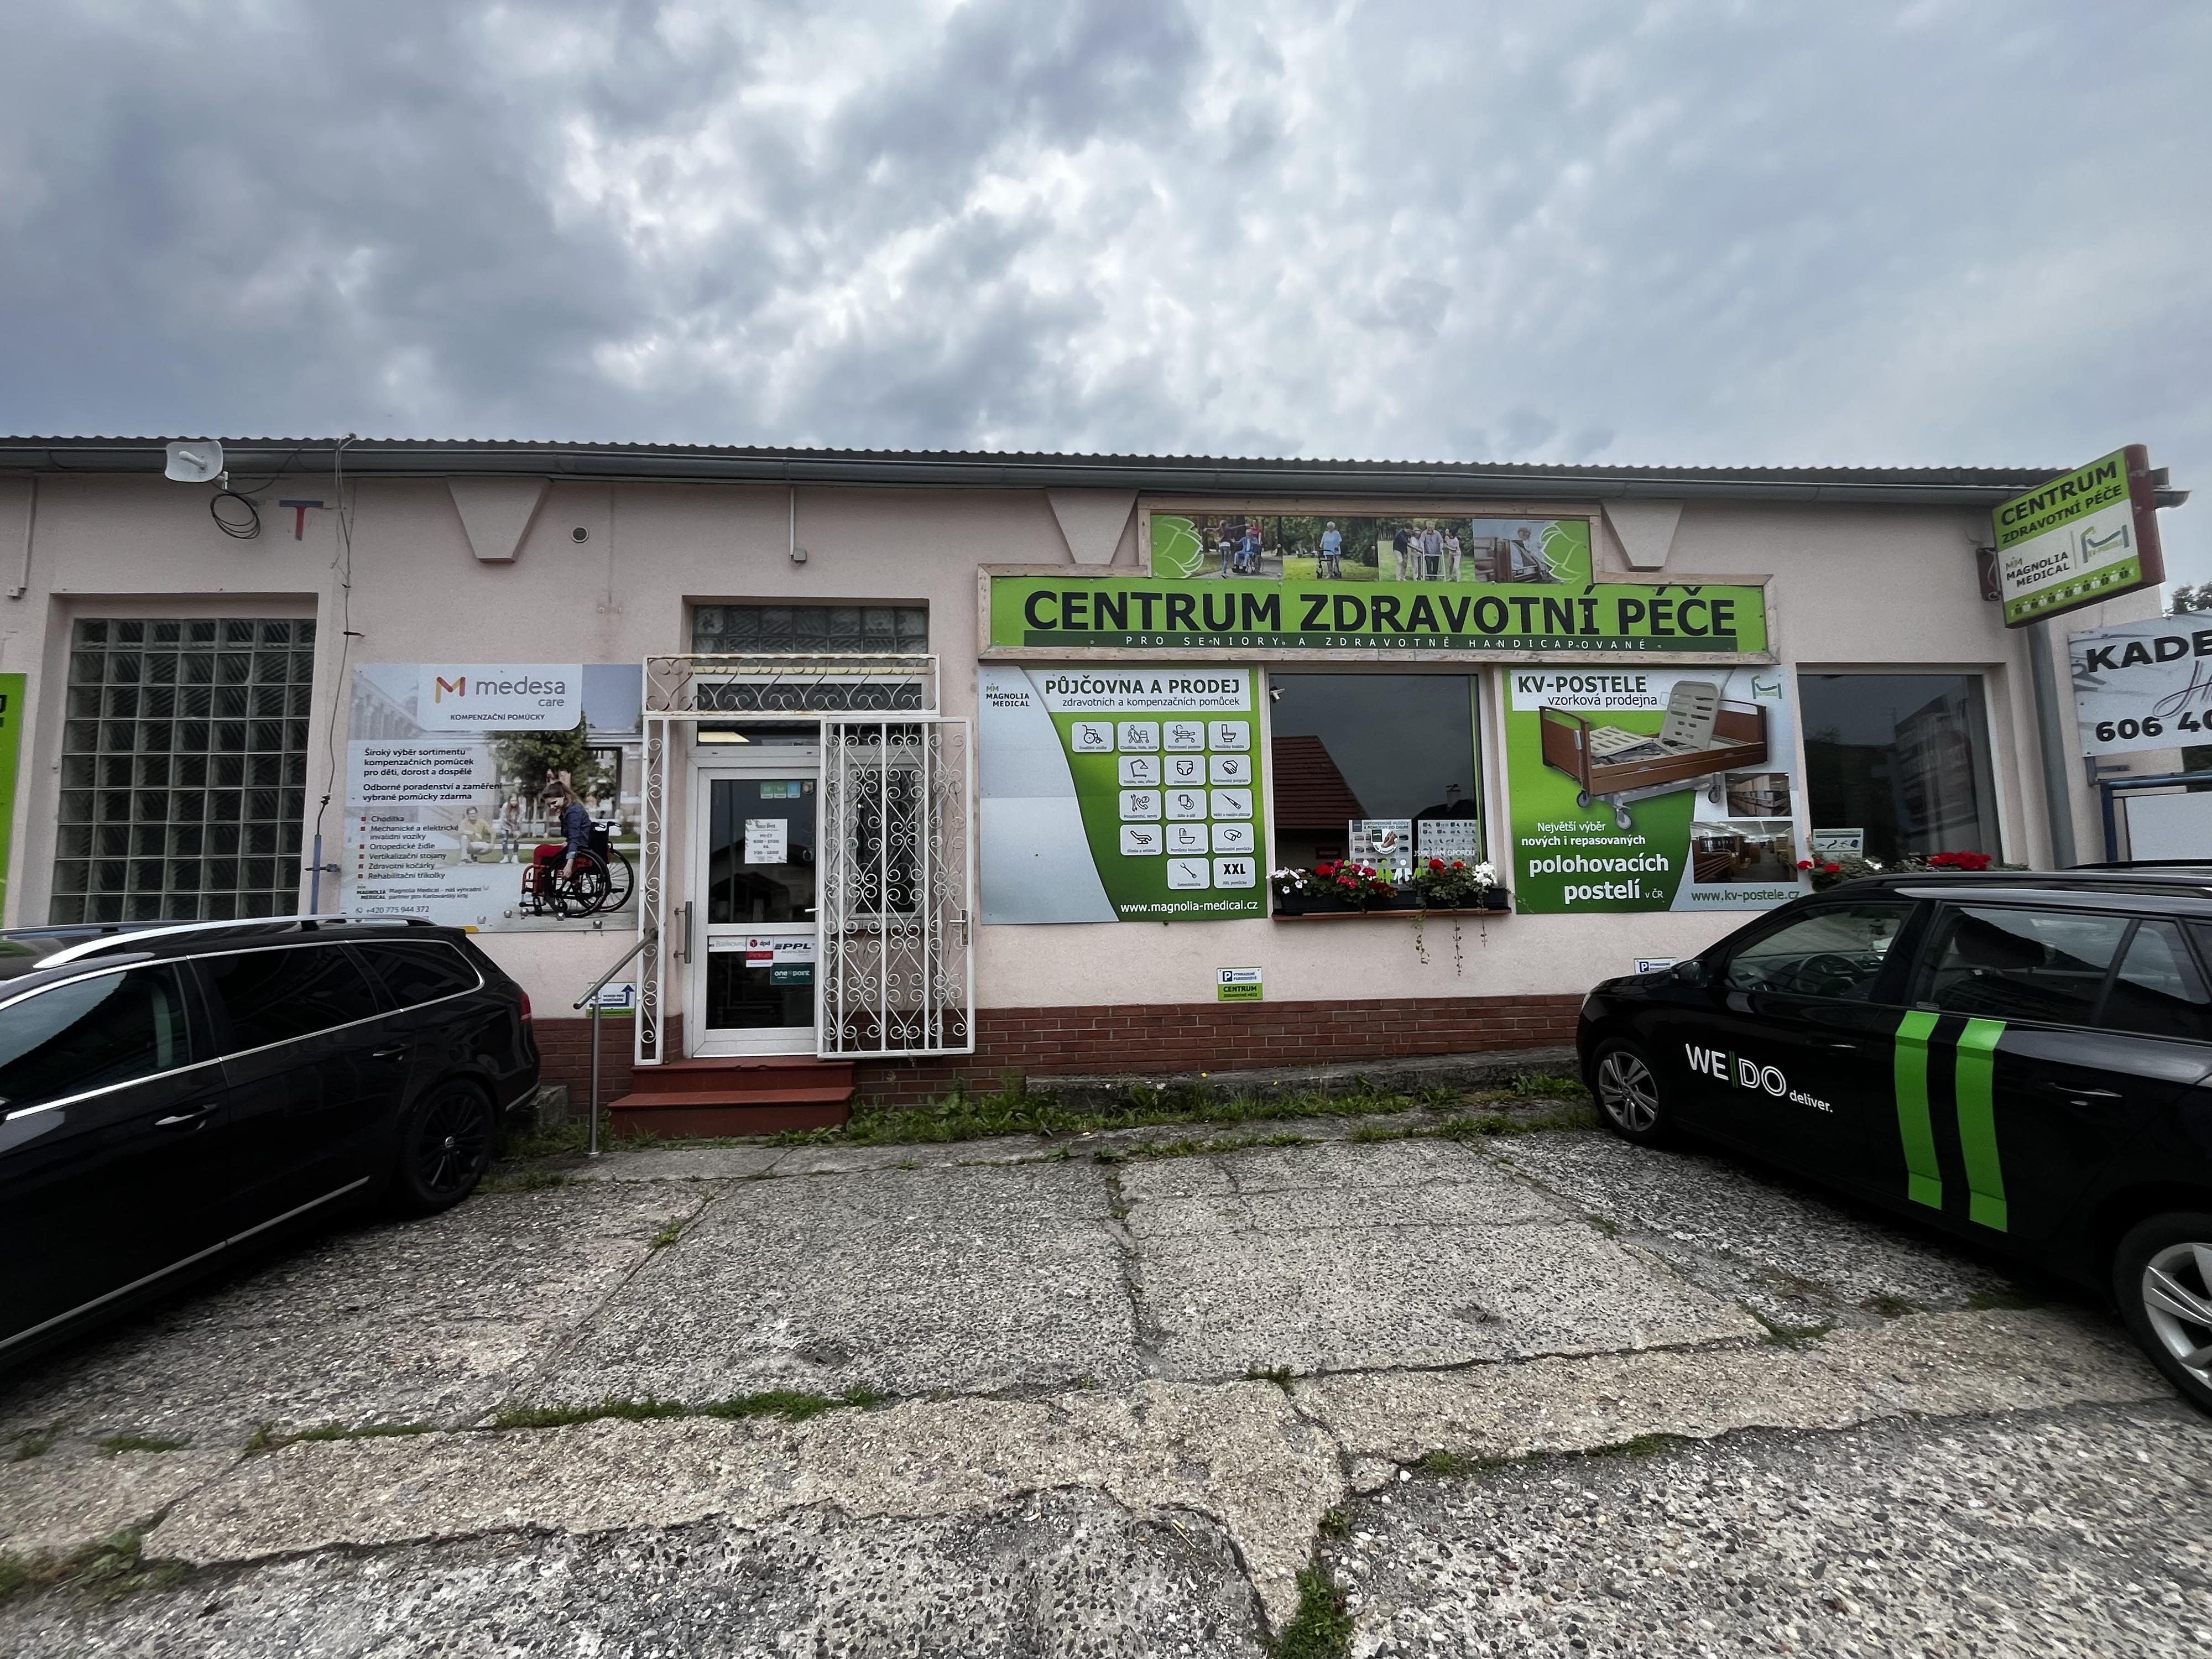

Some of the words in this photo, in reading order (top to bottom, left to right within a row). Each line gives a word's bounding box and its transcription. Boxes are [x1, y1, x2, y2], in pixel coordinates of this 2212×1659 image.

[2001, 461, 2117, 526] CENTRUM
[2002, 502, 2081, 544] ZDRAVOTNÍ
[2085, 484, 2122, 509] PÉČE
[2006, 551, 2069, 581] MAGNOLIA
[2016, 562, 2070, 588] MEDICAL
[1024, 590, 1281, 630] CENTRUM
[1300, 585, 1600, 635] ZDRAVOTNÍ
[1618, 585, 1736, 636] PÉČE
[1125, 635, 1165, 645] PRO
[1183, 636, 1279, 646] SENIORY
[1298, 637, 1306, 646] A
[1325, 636, 1449, 648] ZDRAVOTNĚ
[1469, 638, 1646, 650] HANDICAPOVANÉ
[476, 676, 565, 695] medesa
[1045, 675, 1145, 695] PŮJČOVNA
[1150, 680, 1162, 694] A
[1168, 679, 1240, 694] PRODEJ
[1518, 675, 1647, 693] KV-POSTELE
[538, 697, 565, 707] care
[1062, 696, 1115, 707] zdravotních
[1126, 697, 1196, 708] kompenzačních
[1199, 696, 1240, 708] pomůcek
[1548, 693, 1600, 706] vzorková
[1605, 693, 1657, 708] prodejna
[2096, 716, 2163, 742] 606
[365, 747, 390, 757] Široký
[393, 747, 417, 757] výběr
[364, 757, 432, 766] kompenzačních
[434, 757, 474, 766] pomůcek
[380, 768, 399, 776] děti,
[438, 767, 472, 777] dospělé
[403, 782, 453, 792] poradenství
[462, 782, 502, 791] zaměření
[363, 792, 397, 802] vybrané
[398, 792, 438, 802] pomůcky
[1537, 822, 1577, 832] Největší
[1579, 821, 1606, 833] výběr
[1521, 835, 1561, 848] nových
[1563, 836, 1567, 845] i
[1570, 834, 1646, 848] repasovaných
[405, 862, 435, 870] kočárky
[1223, 863, 1246, 875] XXL
[1529, 853, 1669, 877] polohovacích
[1564, 878, 1641, 904] postelí
[1652, 888, 1663, 899] ČR
[1691, 889, 1800, 903] www.kv-postele.cz
[1120, 899, 1259, 915] www.magnolia-medical.cz
[1685, 1043, 1729, 1081] WE
[1738, 1057, 1787, 1097] DO
[1789, 1089, 1833, 1113] deliver.
